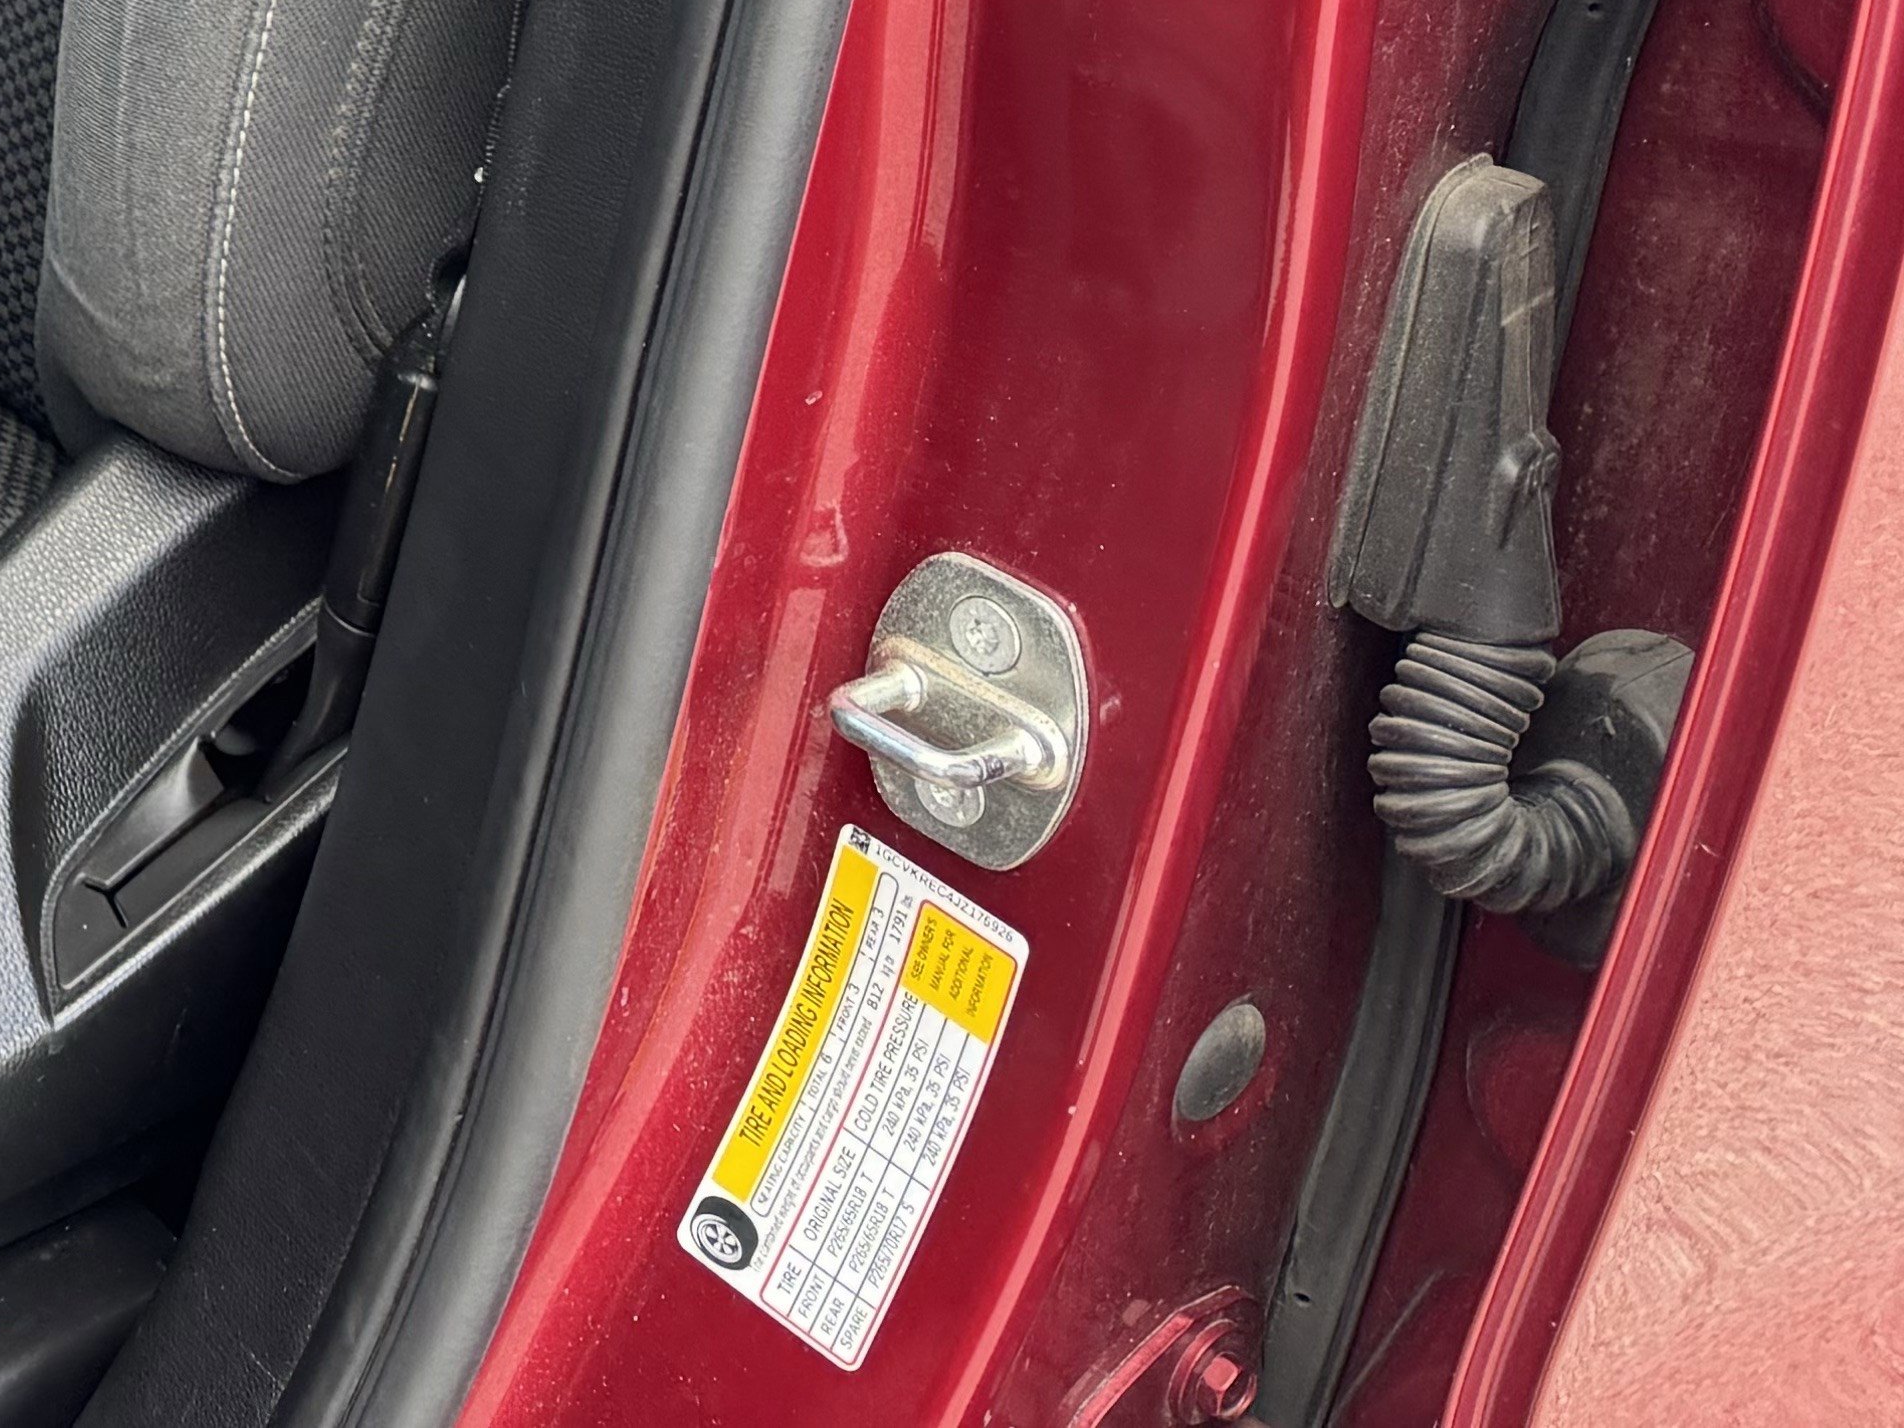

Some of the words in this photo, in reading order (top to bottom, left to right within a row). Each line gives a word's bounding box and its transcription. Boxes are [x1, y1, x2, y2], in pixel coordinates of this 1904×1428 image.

[874, 843, 1015, 943] 1GCVKREC4JZ176926
[800, 897, 854, 1008] INFORMATION
[807, 1069, 827, 1098] TOTAL
[820, 1051, 832, 1064] 6
[836, 995, 855, 1031] FRONT
[847, 982, 859, 994] 3
[871, 905, 884, 918] 3
[866, 982, 884, 1010] 812
[889, 909, 907, 943] 1791
[929, 953, 949, 990] MANUAL
[941, 928, 955, 951] FOR
[948, 947, 973, 1000] ADDITIONAL
[966, 952, 993, 1017] INFORMATION
[771, 1002, 817, 1078] LOADING
[738, 1107, 772, 1146] TIRE
[757, 1072, 786, 1112] AND
[776, 1261, 801, 1294] TIRE
[803, 1180, 842, 1241] ORIGINAL
[833, 1146, 856, 1179] SIZE
[853, 1093, 878, 1131] COLD
[869, 1060, 892, 1092] TIRE
[882, 991, 918, 1063] PRESSURE
[797, 1273, 824, 1318] FRONT
[826, 1185, 867, 1257] P265/65R18
[860, 1171, 873, 1183] T
[881, 1110, 899, 1136] 240
[891, 1086, 913, 1110] kPa,
[904, 1063, 918, 1082] 35
[911, 1038, 929, 1062] PSI
[820, 1297, 844, 1335] REAR
[848, 1201, 888, 1273] P265/65R18
[881, 1186, 894, 1199] T
[903, 1126, 921, 1152] 240
[913, 1101, 934, 1126] kPa,
[925, 1079, 940, 1098] 35
[933, 1052, 950, 1077] PSI
[839, 1306, 867, 1349] SPARE
[864, 1215, 907, 1288] P265/70R17
[900, 1200, 914, 1214] S
[922, 1139, 941, 1166] 240
[932, 1116, 955, 1140] kPa,
[944, 1092, 960, 1112] 35
[952, 1066, 970, 1091] PSI
